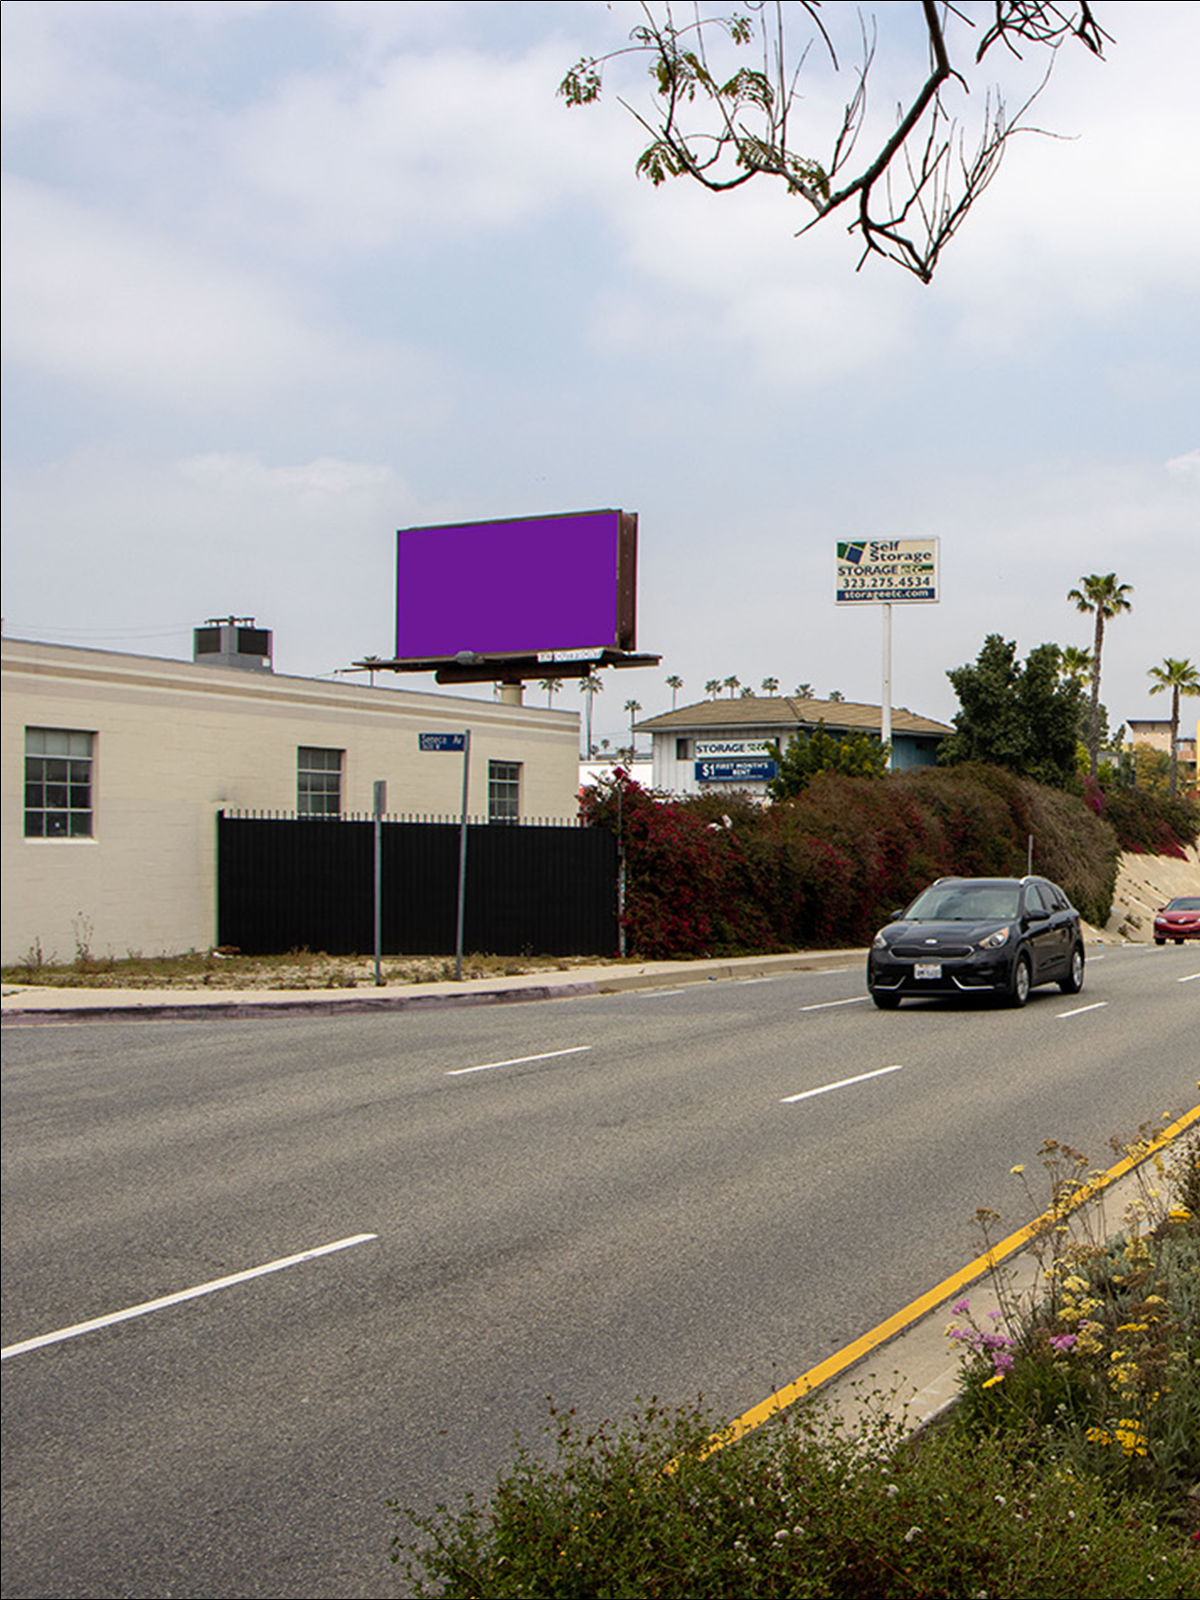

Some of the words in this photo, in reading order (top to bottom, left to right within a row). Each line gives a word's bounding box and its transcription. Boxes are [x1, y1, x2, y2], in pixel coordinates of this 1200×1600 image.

[870, 541, 899, 552] Self
[870, 551, 932, 563] Storage
[838, 565, 898, 576] STORAGE
[843, 577, 930, 588] 323.275.4534
[844, 590, 929, 600] storageetc.com
[696, 743, 746, 754] STORAGE
[702, 763, 715, 777] $1
